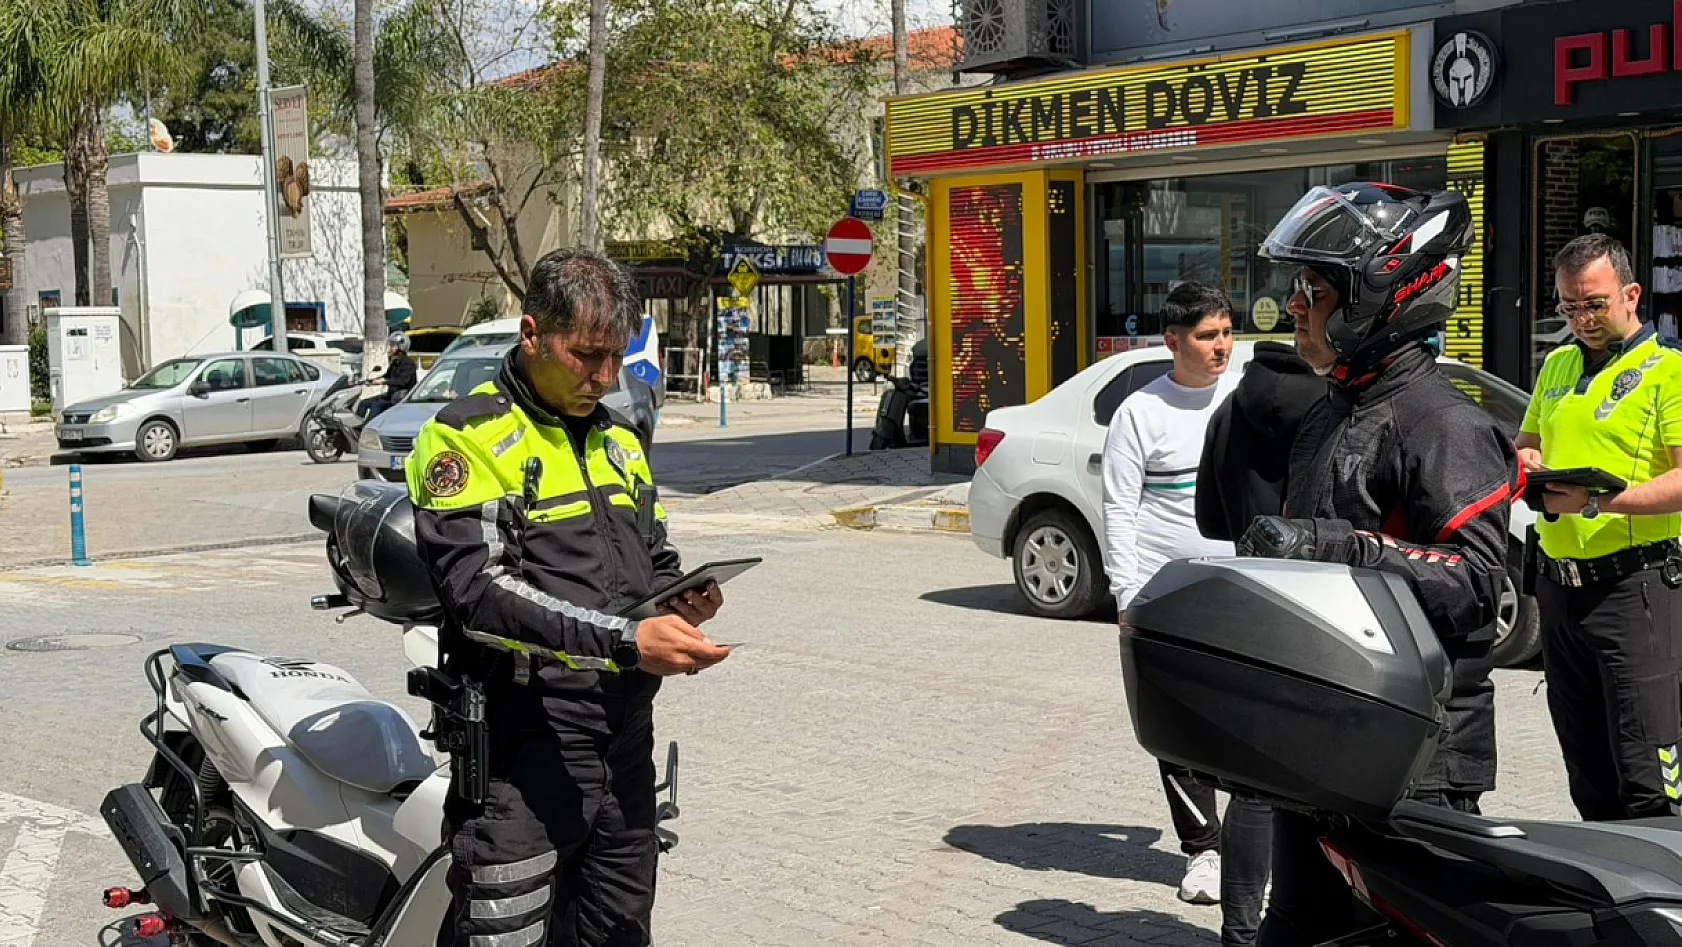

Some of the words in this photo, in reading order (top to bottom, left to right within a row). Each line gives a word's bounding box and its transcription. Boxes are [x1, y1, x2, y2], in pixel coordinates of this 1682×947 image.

[952, 84, 1126, 150] DİKMEN
[1146, 57, 1307, 129] DÖVİZ
[270, 670, 350, 684] HONDA
